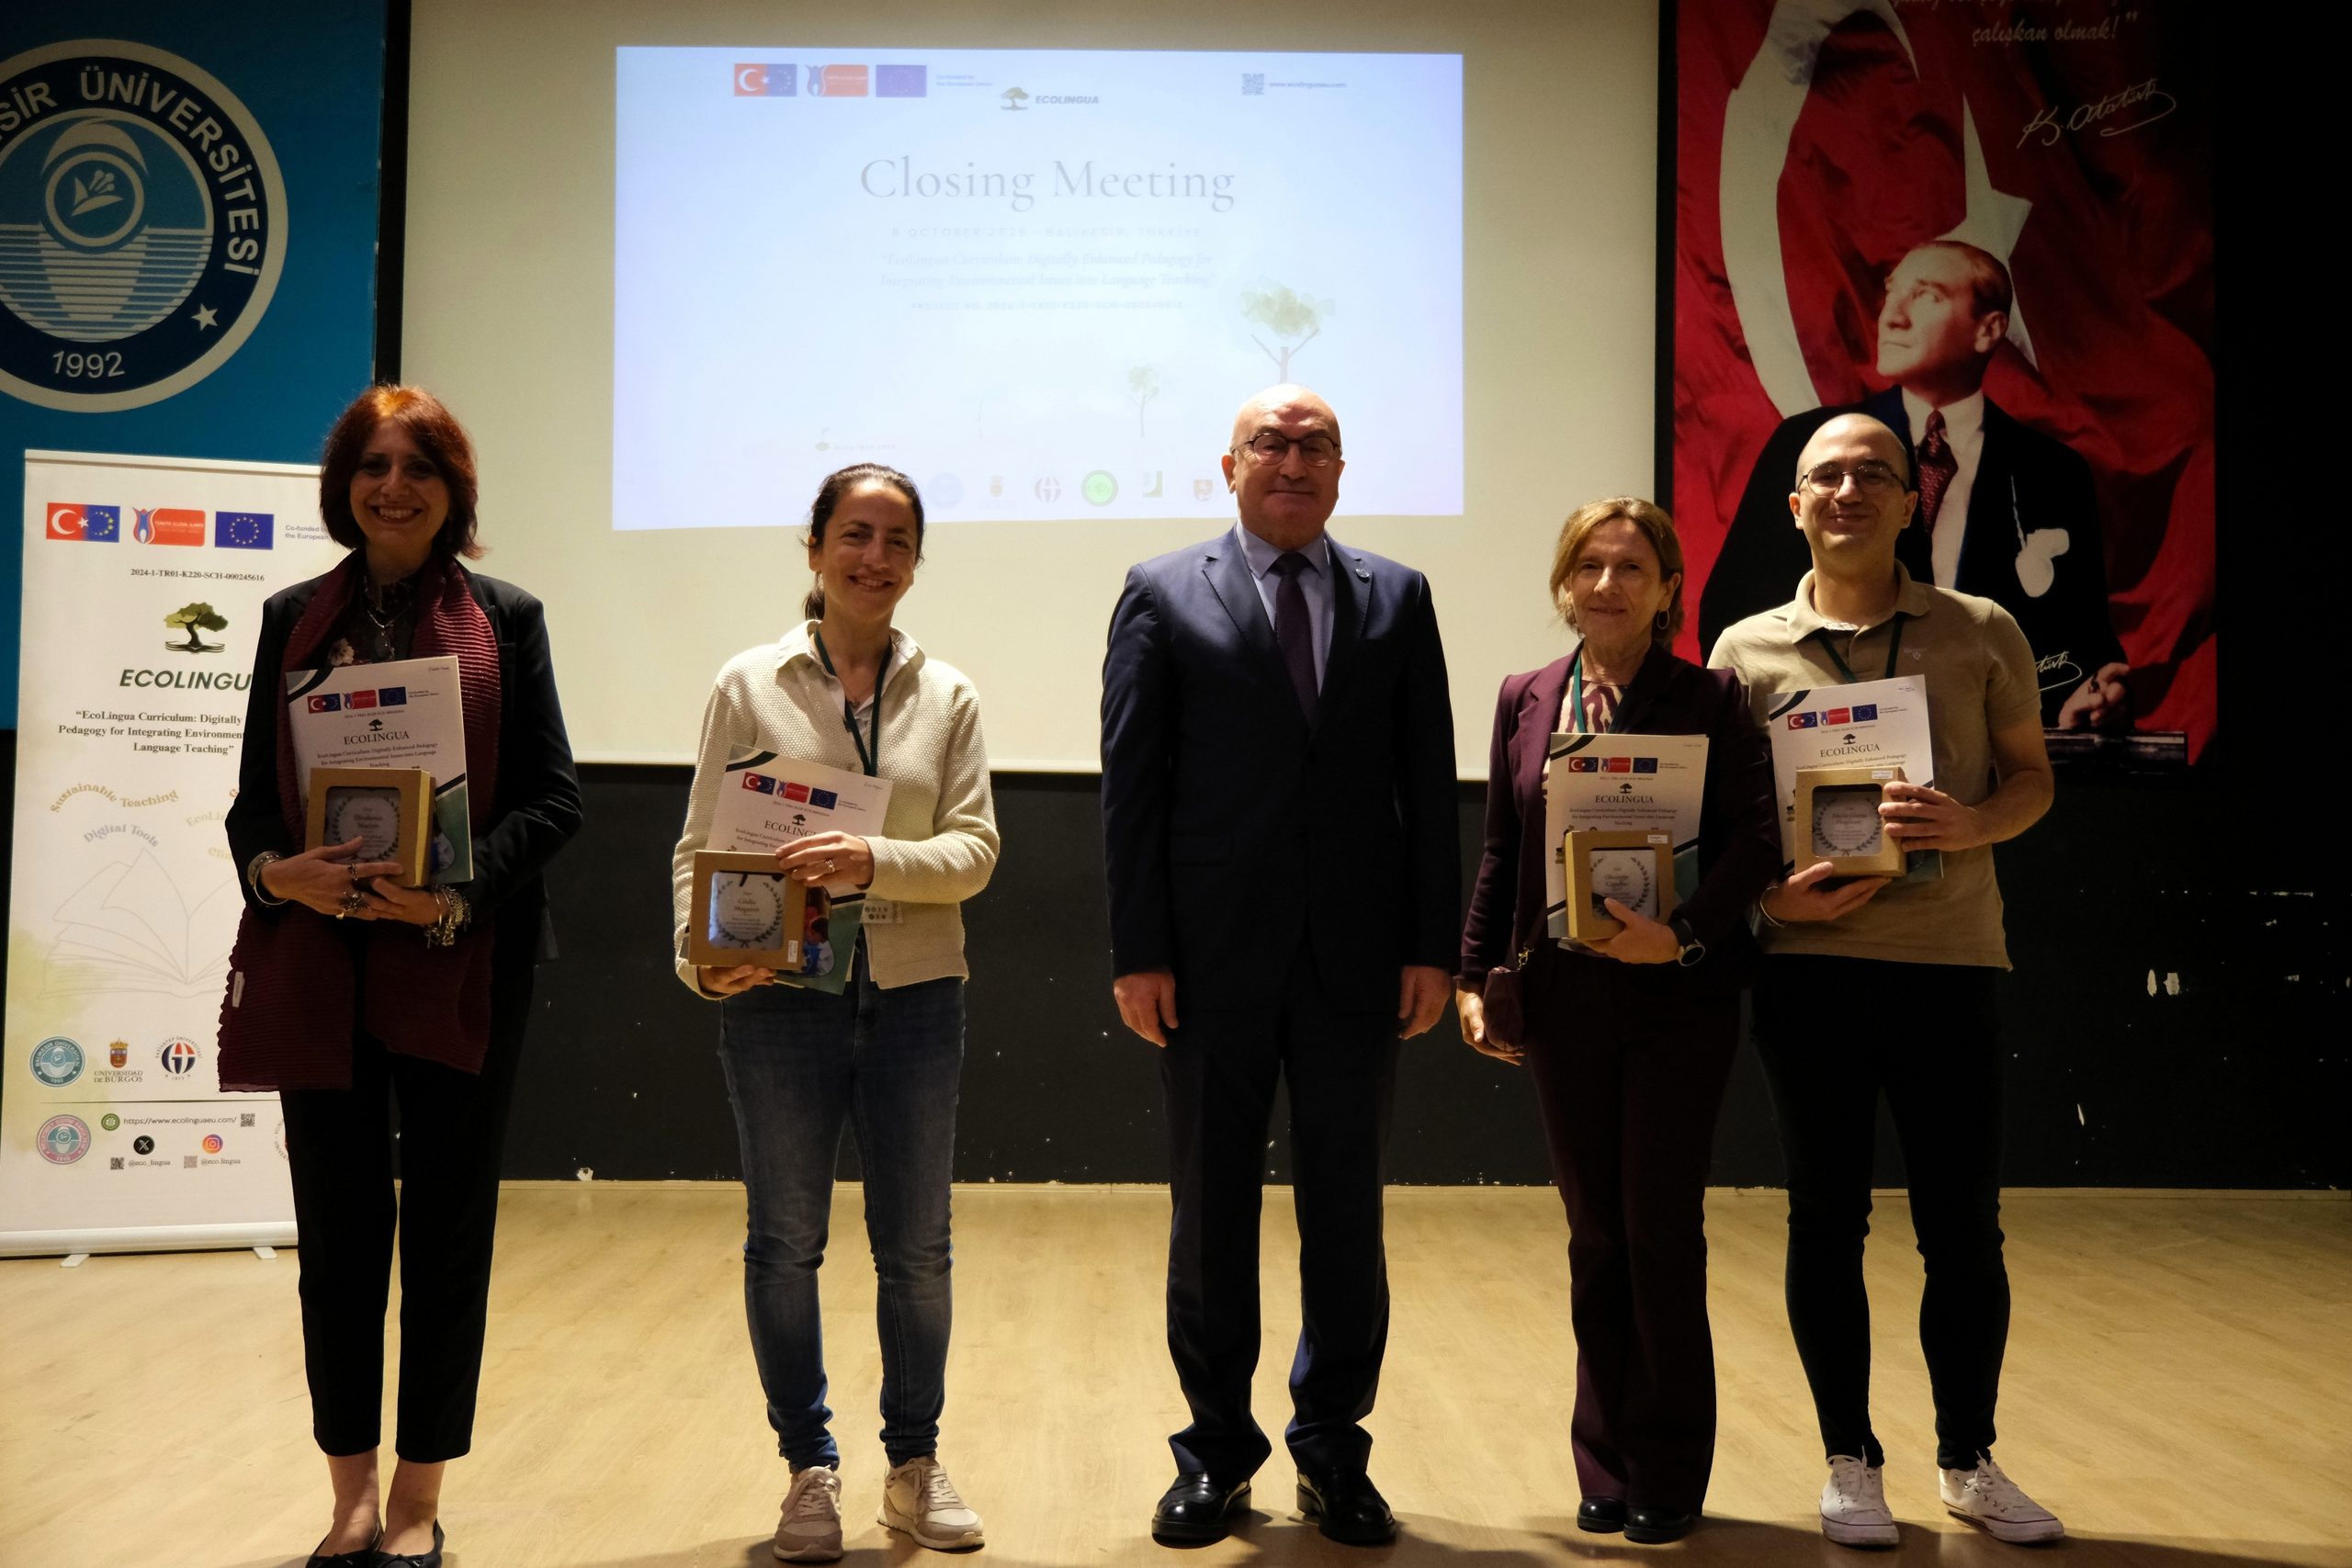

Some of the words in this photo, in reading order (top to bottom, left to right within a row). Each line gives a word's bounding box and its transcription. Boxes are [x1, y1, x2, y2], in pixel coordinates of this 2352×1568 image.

[1972, 18, 2048, 47] çalışkan
[1035, 95, 1100, 105] ECOLINGUA
[0, 81, 58, 142] SİR
[80, 65, 260, 276] ÜNİVERSİTESİ
[861, 154, 1035, 212] Closing
[1052, 159, 1236, 213] Meeting
[907, 227, 981, 237] OCTOBER
[52, 350, 125, 378] 1992
[119, 669, 253, 692] ECOLINGU
[139, 712, 197, 723] Curriculum:
[200, 714, 243, 727] Digitally
[58, 725, 107, 737] Pedagogy
[110, 726, 125, 736] for
[128, 727, 182, 739] Integrating
[185, 728, 244, 739] Environmen
[344, 730, 410, 745] ECOLINGUA
[133, 742, 182, 754] Language
[1820, 743, 1881, 758] ECOLINGUA
[50, 783, 118, 814] Sustainable
[119, 789, 179, 808] Teaching
[1595, 795, 1654, 804] ECOLINGUA
[83, 824, 128, 843] Digital
[130, 825, 159, 847] Tools
[764, 820, 816, 837] ECOLING
[123, 1116, 237, 1126] https://www.ecolinguaeu.com/
